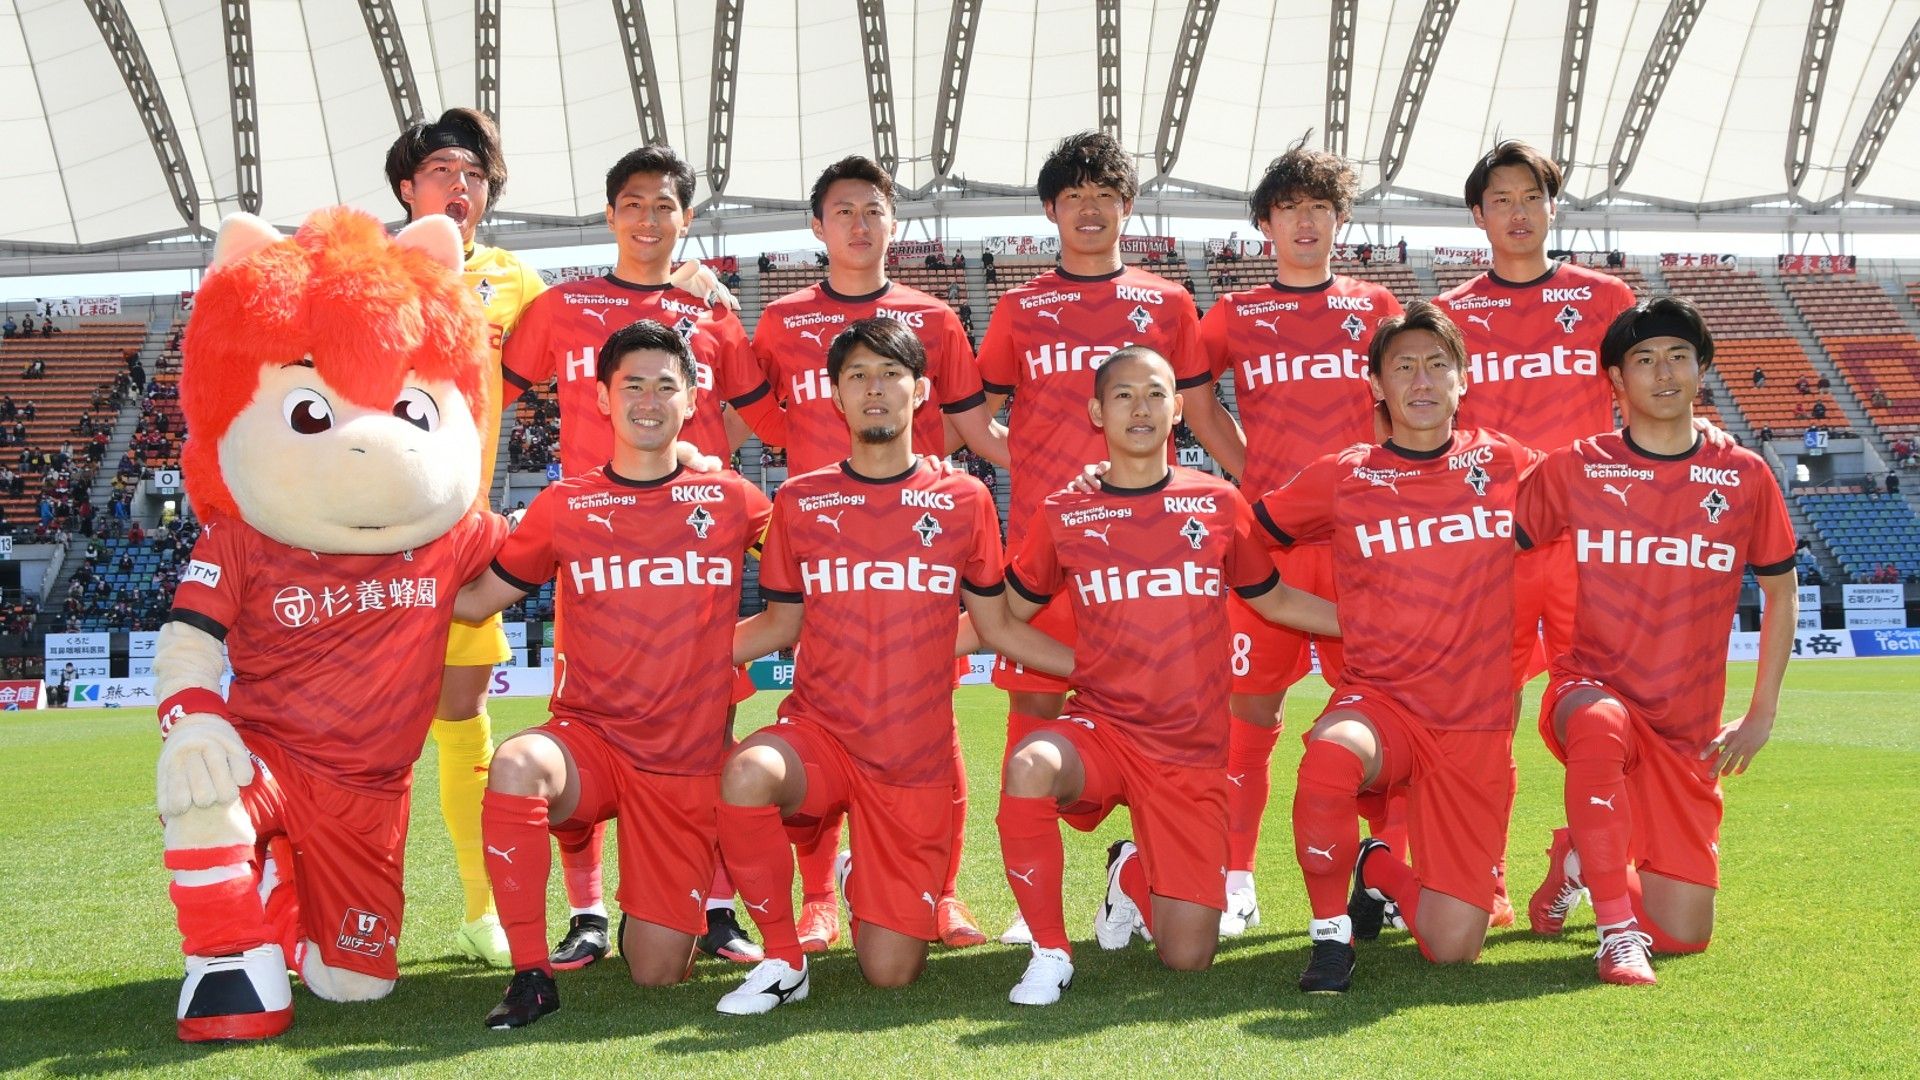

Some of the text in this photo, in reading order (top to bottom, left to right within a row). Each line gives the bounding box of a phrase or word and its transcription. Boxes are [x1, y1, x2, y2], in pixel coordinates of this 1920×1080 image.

[1435, 247, 1488, 258] Miyazaki
[565, 296, 629, 306] Technology
[1021, 291, 1081, 309] Technology
[1116, 285, 1164, 305] RKKCS
[1327, 296, 1374, 311] RKKCS
[1542, 286, 1592, 303] RKKCS
[1239, 302, 1299, 316] Technology
[1450, 298, 1511, 310] Technology
[785, 314, 844, 329] Technology
[1819, 434, 1826, 445] 7
[1186, 451, 1198, 462] M
[1448, 446, 1494, 470] RKKCS
[1585, 468, 1655, 480] Technology
[1690, 465, 1740, 487] RKKCS
[569, 495, 637, 510] Technology
[672, 485, 725, 502] RKKCS
[901, 489, 955, 510] RKKCS
[800, 494, 866, 512] Technology
[1164, 497, 1217, 513] RKKCS
[1062, 508, 1132, 527] Technology
[1354, 505, 1513, 558] Hirata
[1577, 529, 1736, 572] Hirata
[570, 551, 732, 594] Hirata
[800, 556, 957, 596] Hirata
[1074, 561, 1221, 606] Hirata
[320, 578, 437, 618] 杉養蜂園
[1231, 632, 1251, 676] 8
[773, 665, 794, 685] 明
